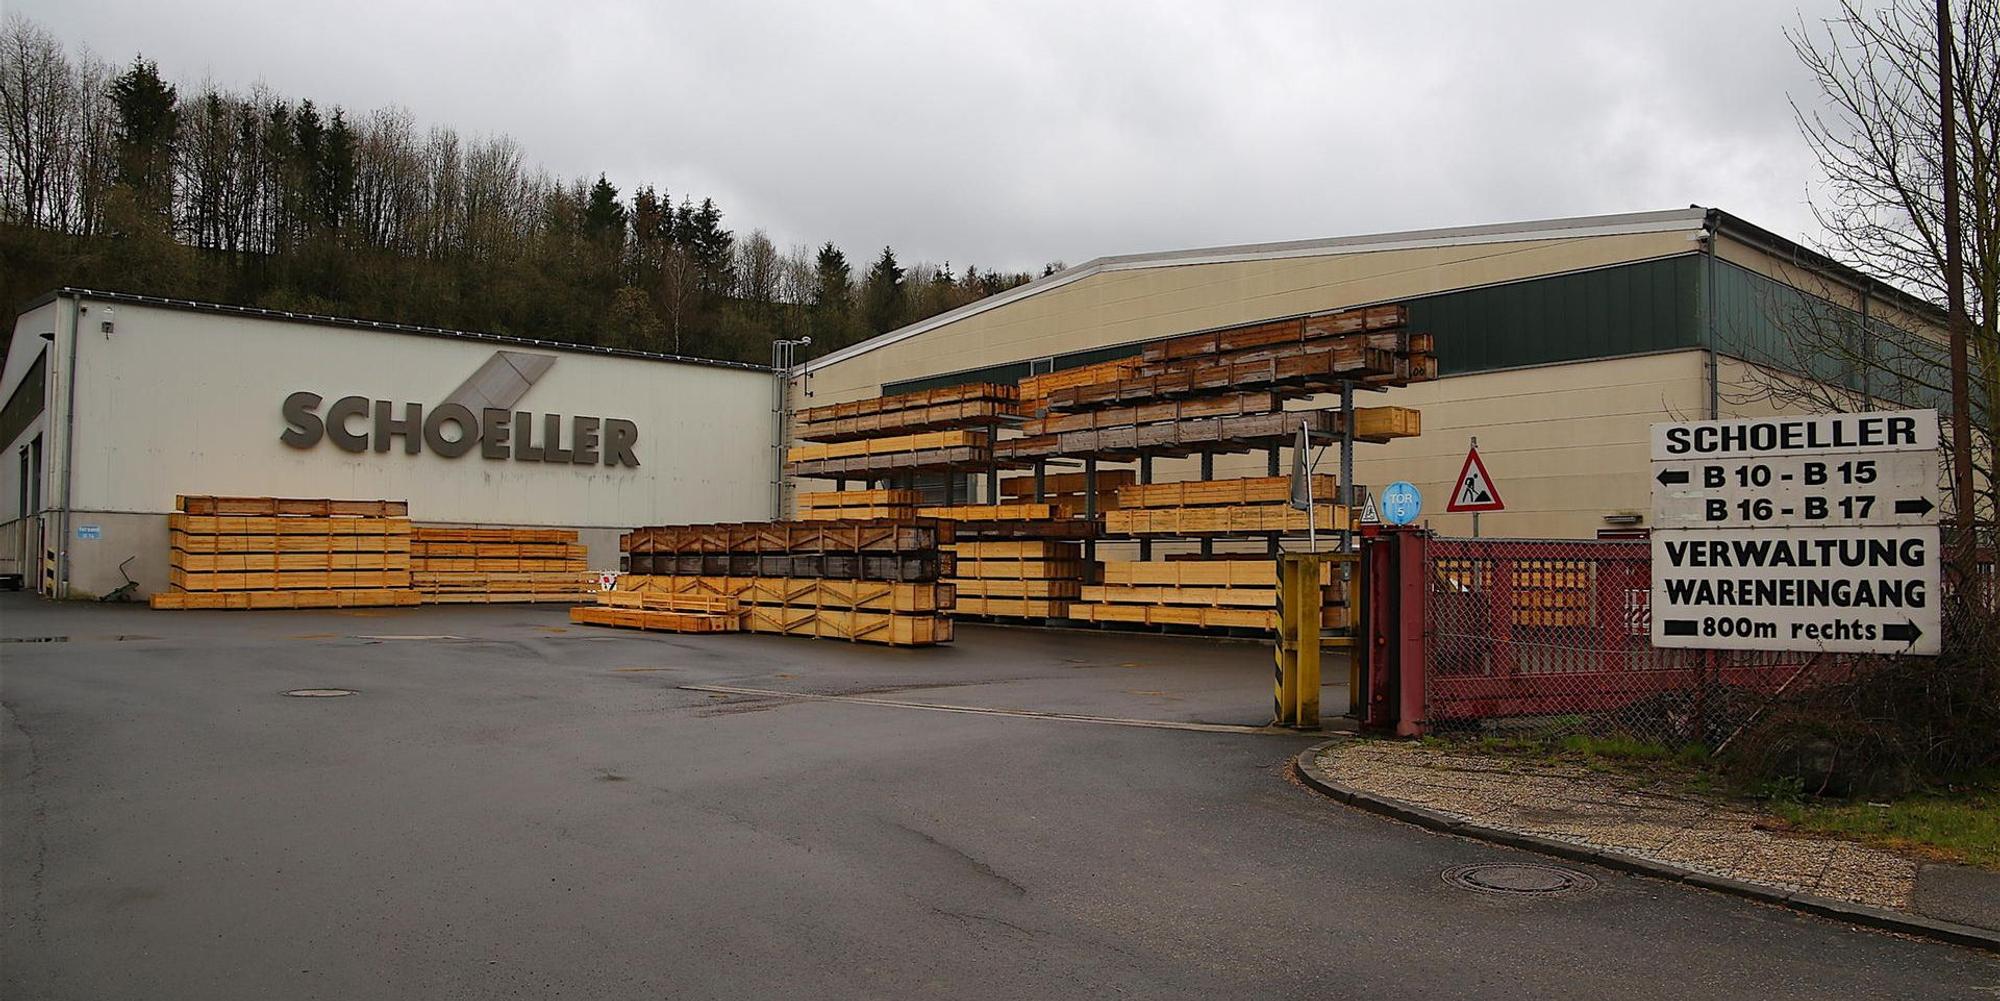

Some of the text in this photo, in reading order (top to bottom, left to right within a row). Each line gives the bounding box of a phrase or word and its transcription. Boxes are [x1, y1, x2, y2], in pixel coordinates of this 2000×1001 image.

[280, 391, 641, 467] SCHOELLER
[1666, 416, 1917, 453] SCHOELLER
[1704, 465, 1726, 488] B
[1735, 464, 1771, 487] 10
[1804, 462, 1828, 485] B
[1837, 460, 1877, 484] 15
[1390, 493, 1413, 503] TOR
[1706, 499, 1728, 521] B
[1737, 498, 1773, 521] 16
[1805, 496, 1828, 519] B
[1838, 496, 1876, 519] 17
[1397, 508, 1405, 517] 5
[1665, 539, 1925, 567] VERWALTUNG
[1665, 579, 1926, 608] WARENEINGANG
[1703, 617, 1877, 641] 800m rechts
